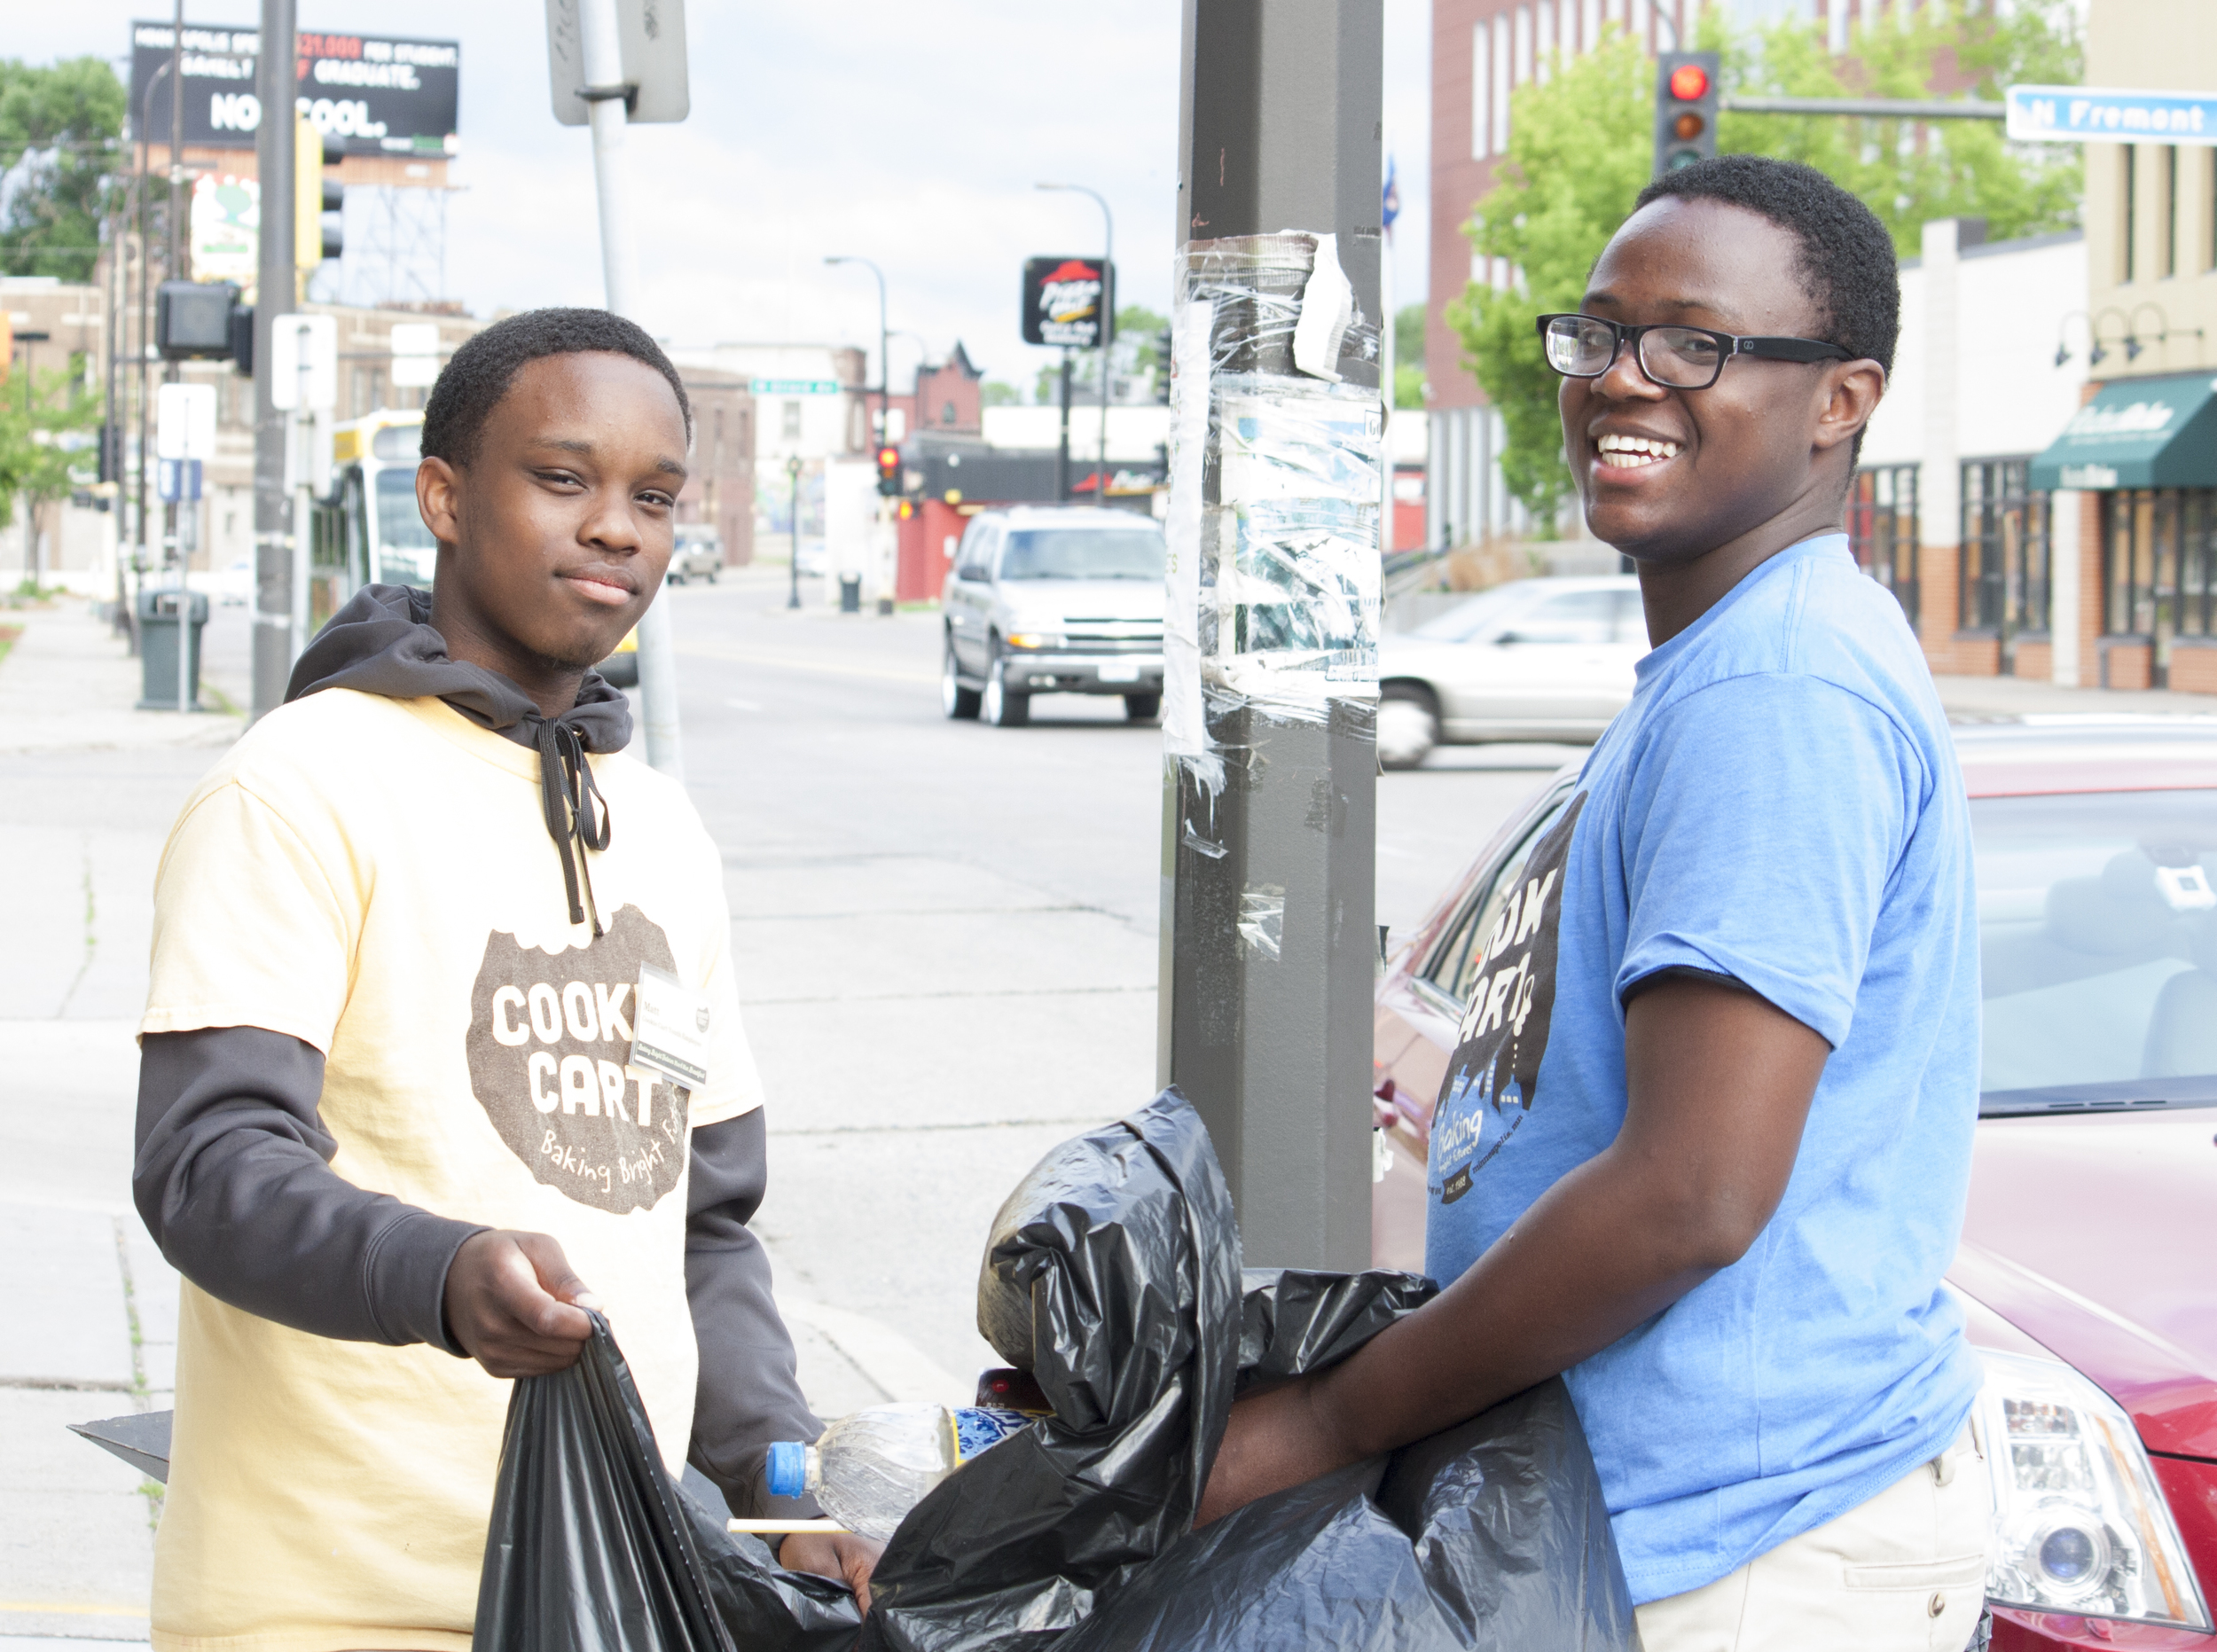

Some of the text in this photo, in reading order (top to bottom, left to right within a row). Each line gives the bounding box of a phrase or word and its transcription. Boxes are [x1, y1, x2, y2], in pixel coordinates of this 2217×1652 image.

[210, 93, 262, 131] NO
[2070, 99, 2205, 132] Fremont
[492, 981, 640, 1046] COOK
[528, 1051, 663, 1127] CART
[1438, 1109, 1483, 1161] Baking
[1472, 1131, 1513, 1175] minneapolis,
[541, 1130, 665, 1194] Baking Bright
